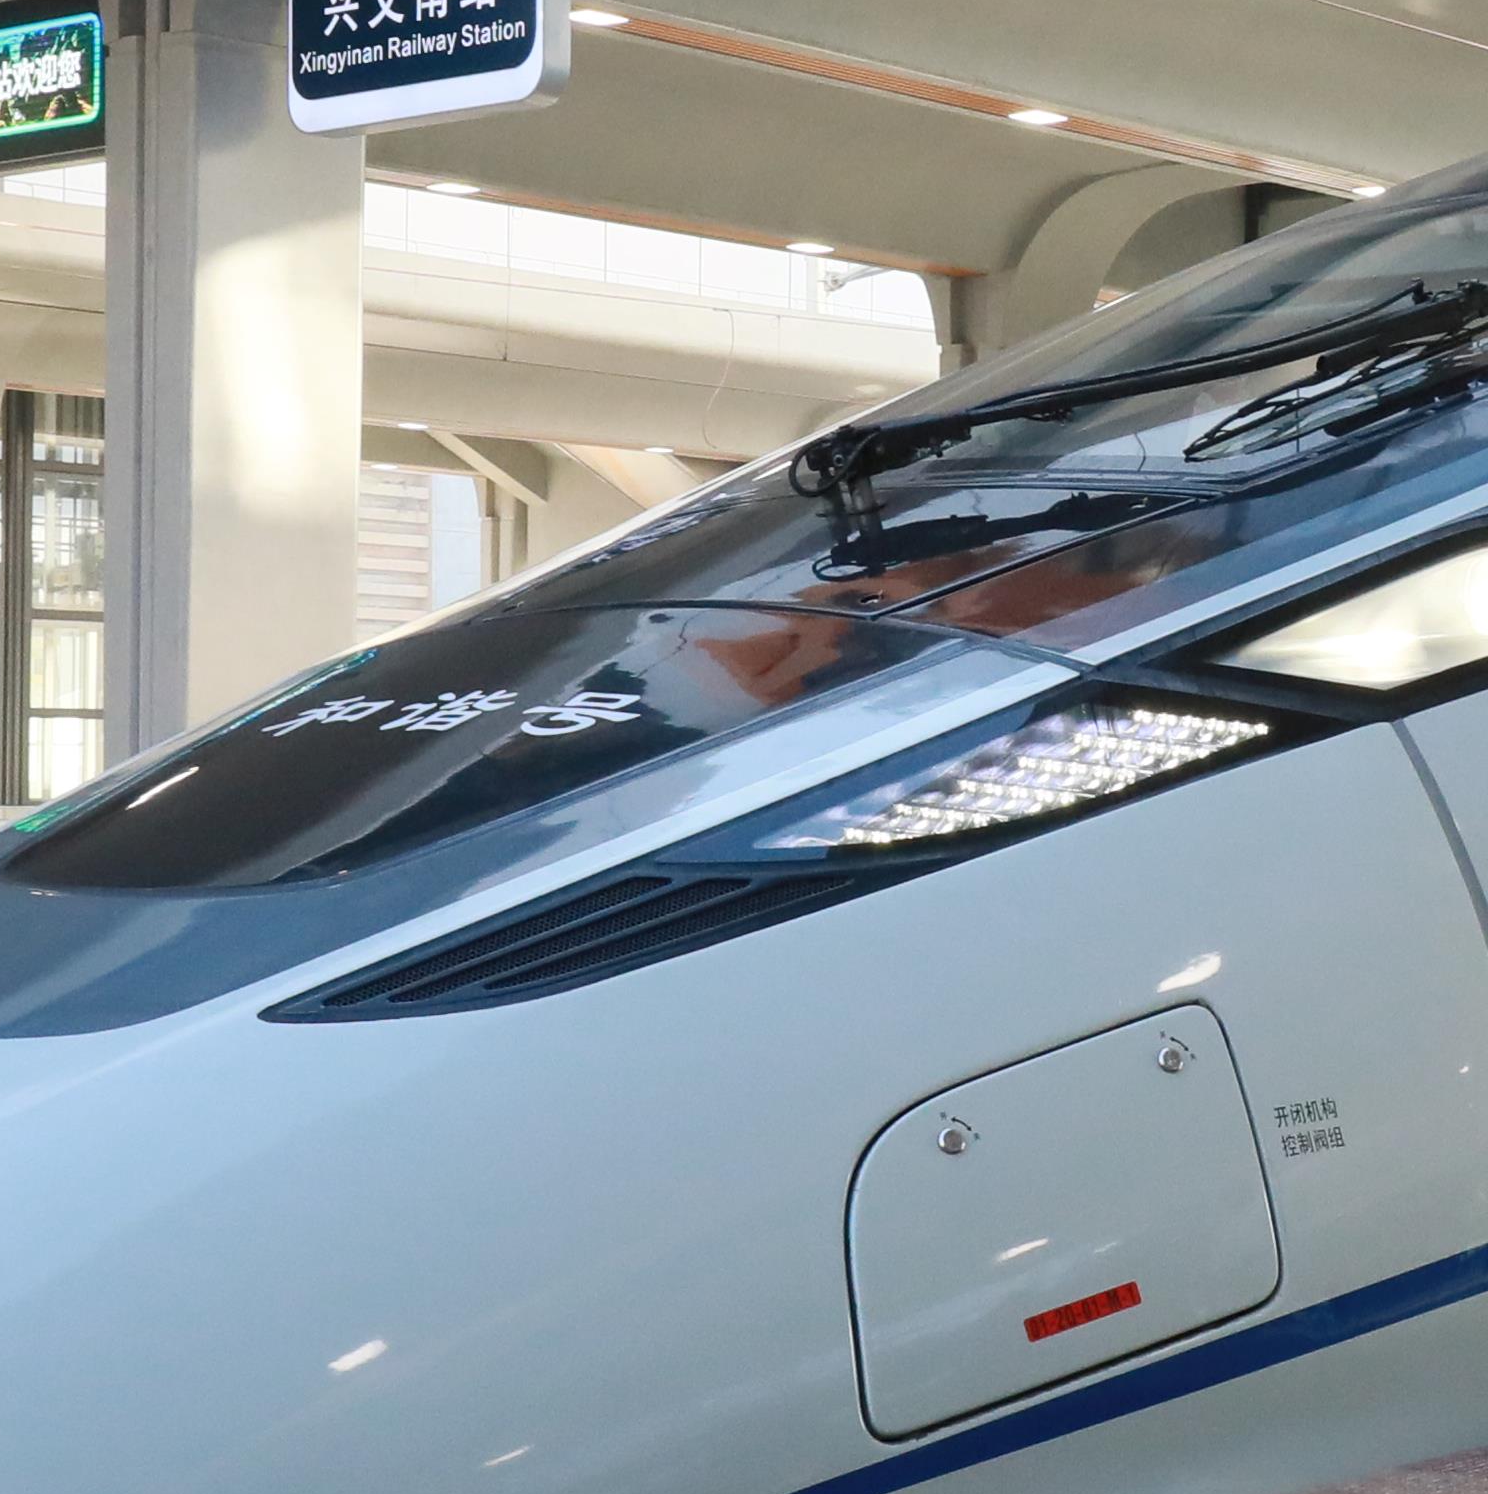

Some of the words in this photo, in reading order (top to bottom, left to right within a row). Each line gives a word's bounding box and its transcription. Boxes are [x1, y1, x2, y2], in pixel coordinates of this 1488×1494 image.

[300, 44, 383, 75] Xingyinan
[388, 30, 457, 60] Railway
[461, 19, 525, 46] Station
[262, 689, 642, 738] 和谐号
[1273, 1097, 1338, 1128] 开闭机构
[1281, 1126, 1345, 1157] 控制阀组
